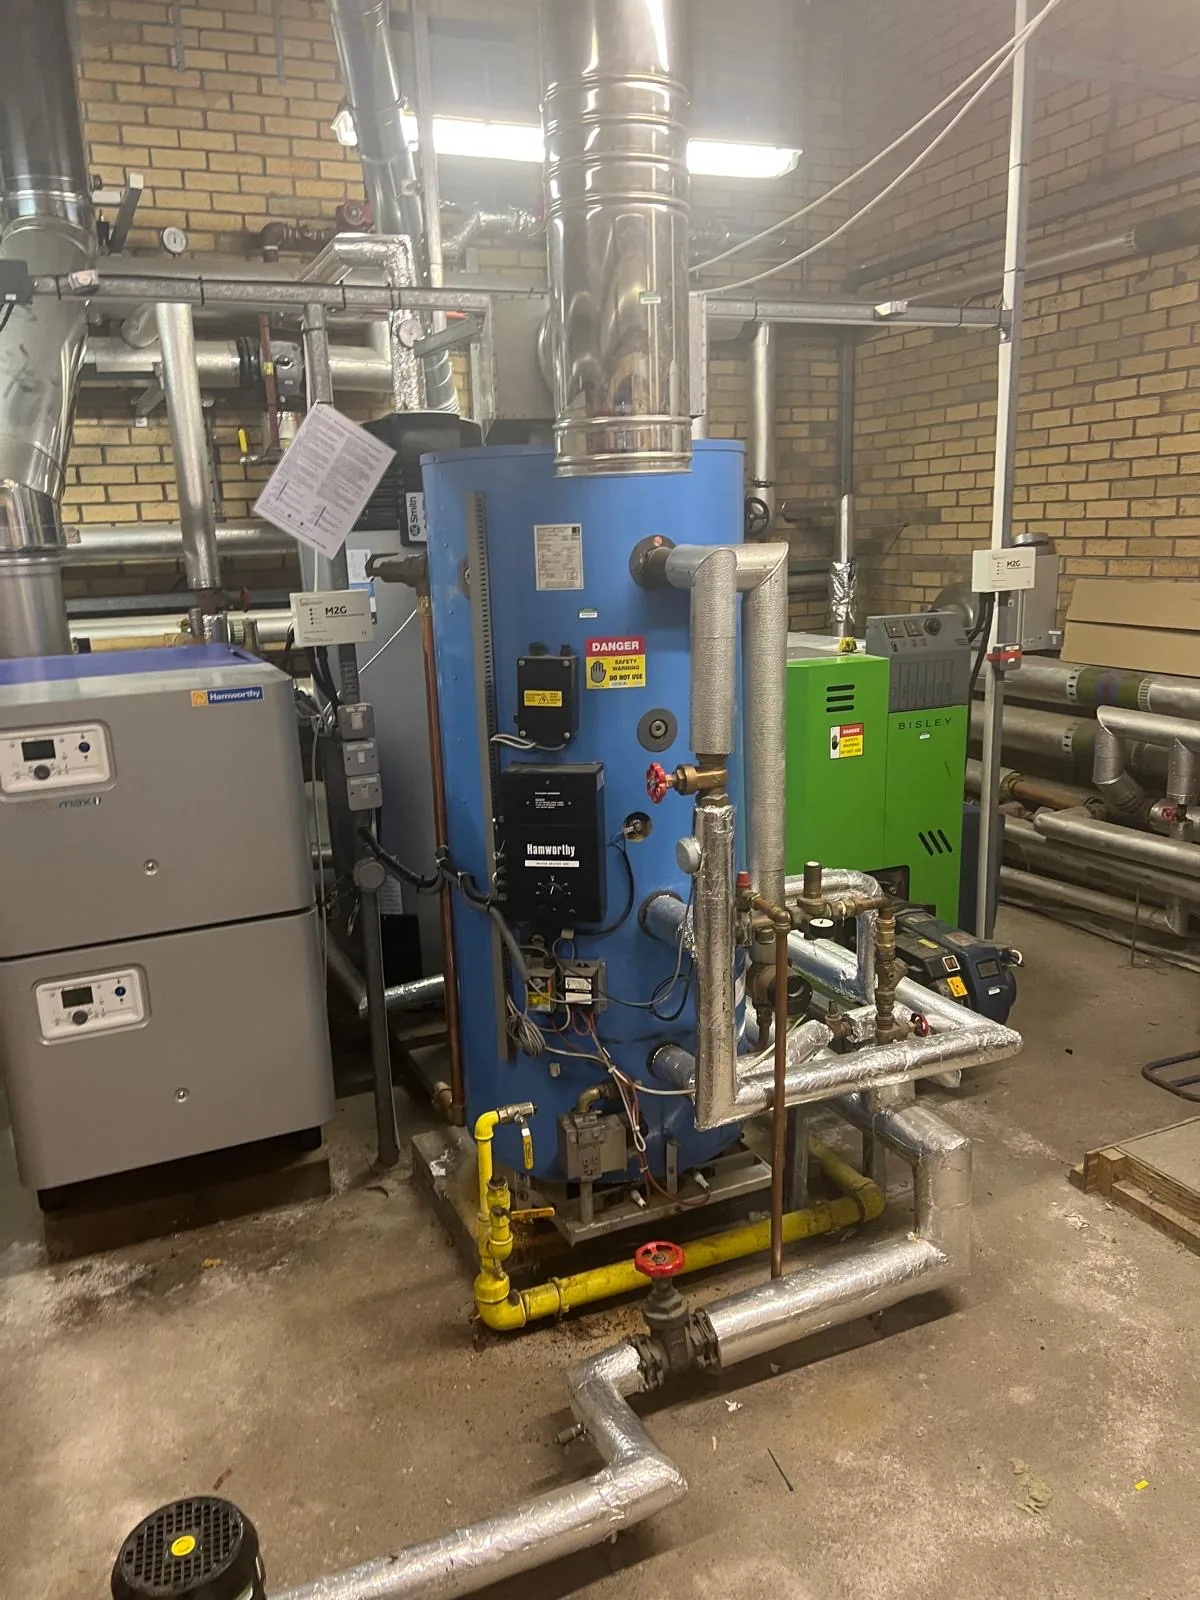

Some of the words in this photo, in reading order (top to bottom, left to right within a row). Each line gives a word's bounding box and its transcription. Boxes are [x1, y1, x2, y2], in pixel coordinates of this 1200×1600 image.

[409, 496, 418, 523] Smith
[325, 605, 347, 615] M2G
[591, 640, 640, 652] DANGER
[209, 690, 261, 701] Hamworthy
[898, 717, 952, 730] BISLEY
[526, 843, 575, 857] Hamworthy
